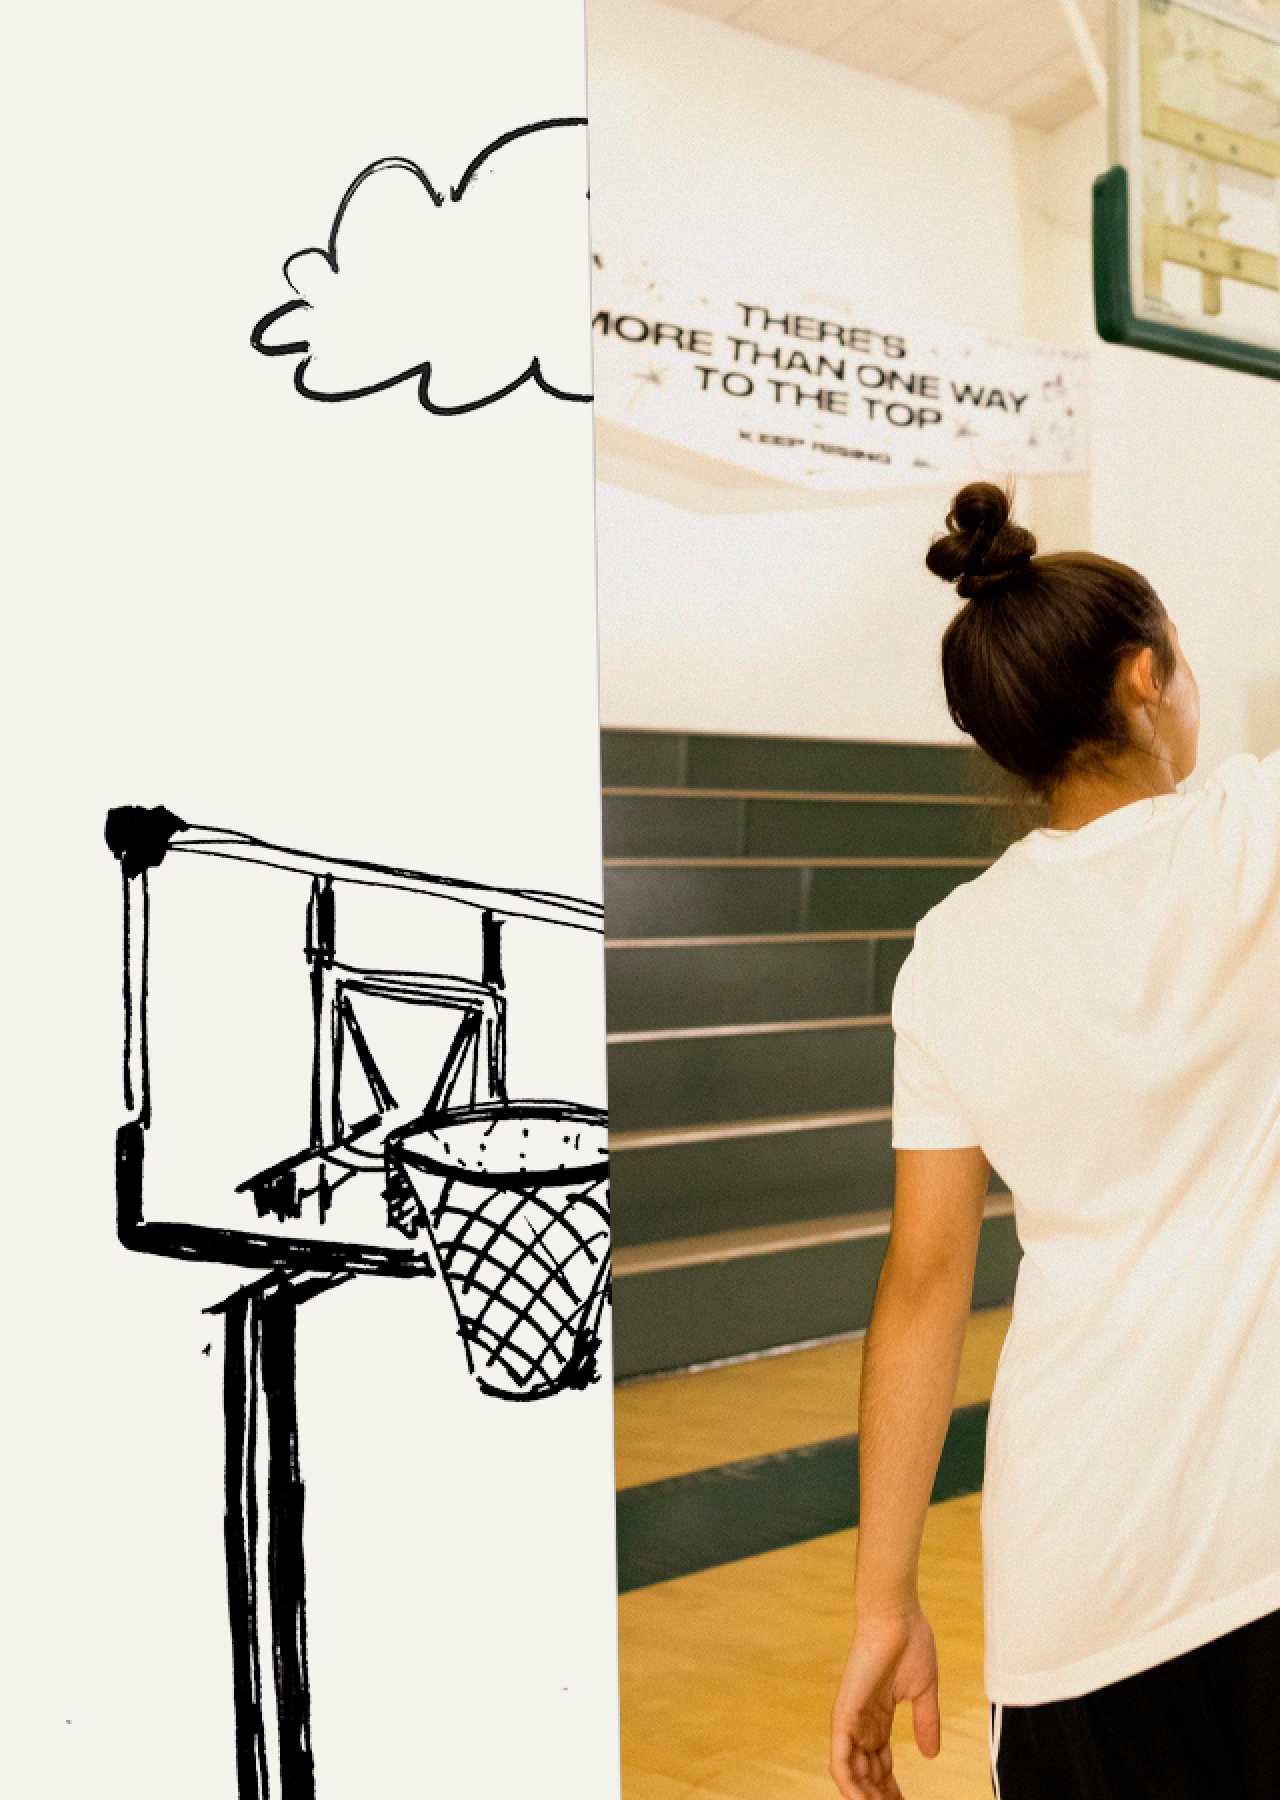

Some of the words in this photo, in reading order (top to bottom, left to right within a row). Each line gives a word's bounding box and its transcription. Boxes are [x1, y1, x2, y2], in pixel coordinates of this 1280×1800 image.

[736, 301, 907, 358] THERE'S
[694, 364, 755, 397] TO
[767, 377, 849, 416] THE
[863, 394, 943, 429] TOP
[727, 335, 844, 381] THAN
[856, 364, 939, 399] ONE
[950, 379, 1028, 414] WAY
